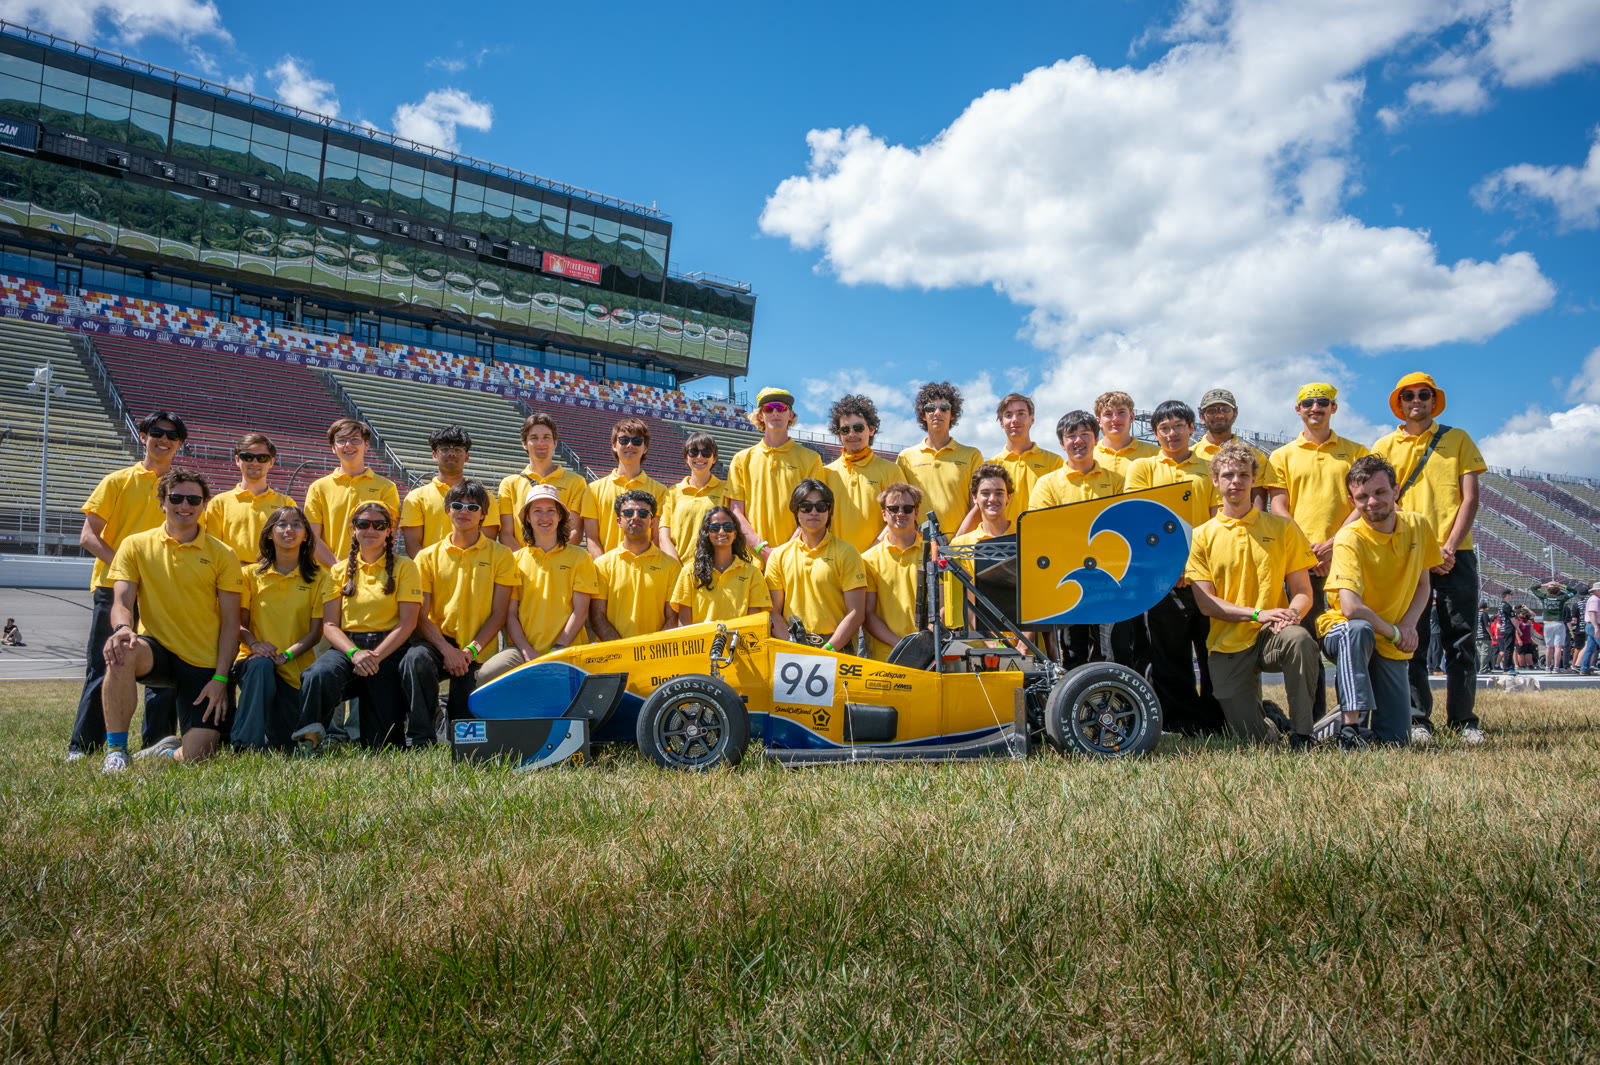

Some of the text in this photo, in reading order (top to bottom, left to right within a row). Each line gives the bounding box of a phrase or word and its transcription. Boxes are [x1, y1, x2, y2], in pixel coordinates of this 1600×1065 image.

[31, 312, 50, 324] ally
[82, 320, 100, 332] ally
[133, 330, 150, 340] ally
[180, 337, 196, 346] ally
[223, 344, 239, 354] ally
[266, 351, 280, 360] ally
[306, 357, 320, 366] ally
[346, 364, 360, 372] ally
[384, 369, 397, 378] ally
[418, 374, 432, 384] ally
[453, 380, 466, 388] ally
[486, 384, 498, 393] ally
[520, 390, 532, 398] ally
[550, 394, 562, 403] ally
[633, 638, 706, 662] UC SANTA CRUZ
[838, 664, 862, 676] SAE
[879, 670, 906, 679] Calspan
[780, 662, 828, 697] 96
[455, 722, 486, 738] SAE
